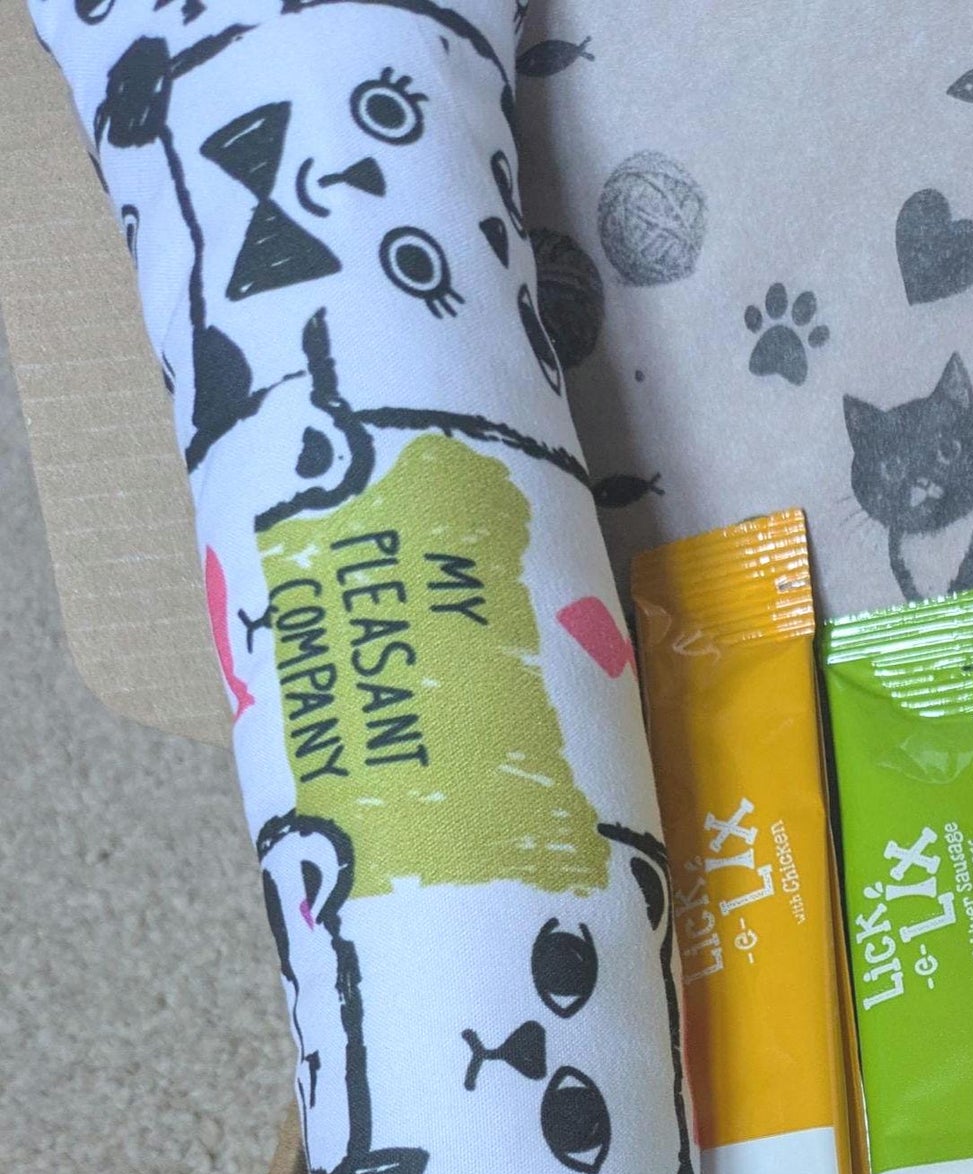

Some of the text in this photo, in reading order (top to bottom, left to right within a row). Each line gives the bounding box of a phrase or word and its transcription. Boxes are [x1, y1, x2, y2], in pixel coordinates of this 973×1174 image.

[423, 551, 488, 626] MY
[268, 577, 349, 783] COMPANY
[330, 529, 430, 767] PLEASANT
[944, 822, 973, 893] Sausage
[789, 895, 807, 925] with
